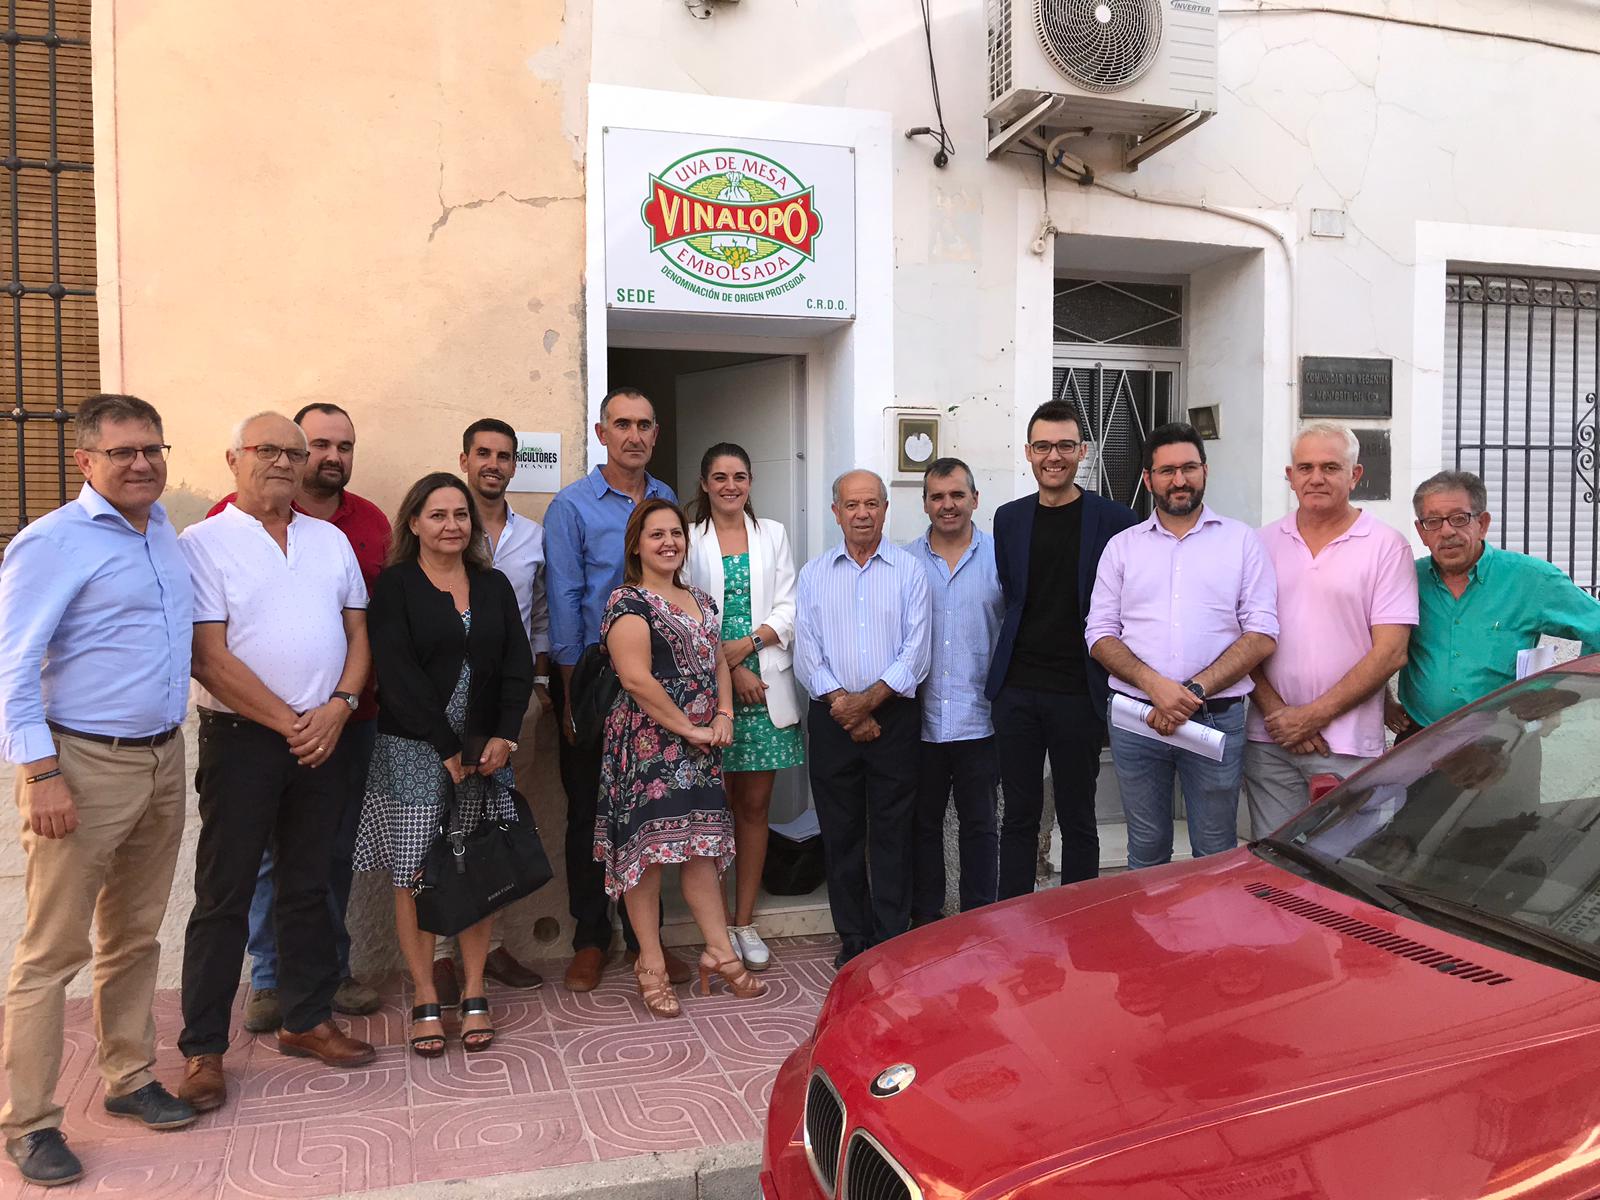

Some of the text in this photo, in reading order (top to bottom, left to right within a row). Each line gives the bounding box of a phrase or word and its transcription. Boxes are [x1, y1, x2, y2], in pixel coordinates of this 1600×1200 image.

[1174, 2, 1211, 13] INVERTER
[675, 156, 787, 191] UVA DE MESA
[657, 188, 808, 245] VINALOPÓ
[676, 247, 790, 281] EMBOLSADA
[616, 288, 655, 304] SEDE
[660, 264, 806, 303] DENOMINACIÓN DE ORIGEN PROTEGIDA
[806, 298, 848, 311] C.R.D.O.
[515, 451, 557, 463] RICULTORES
